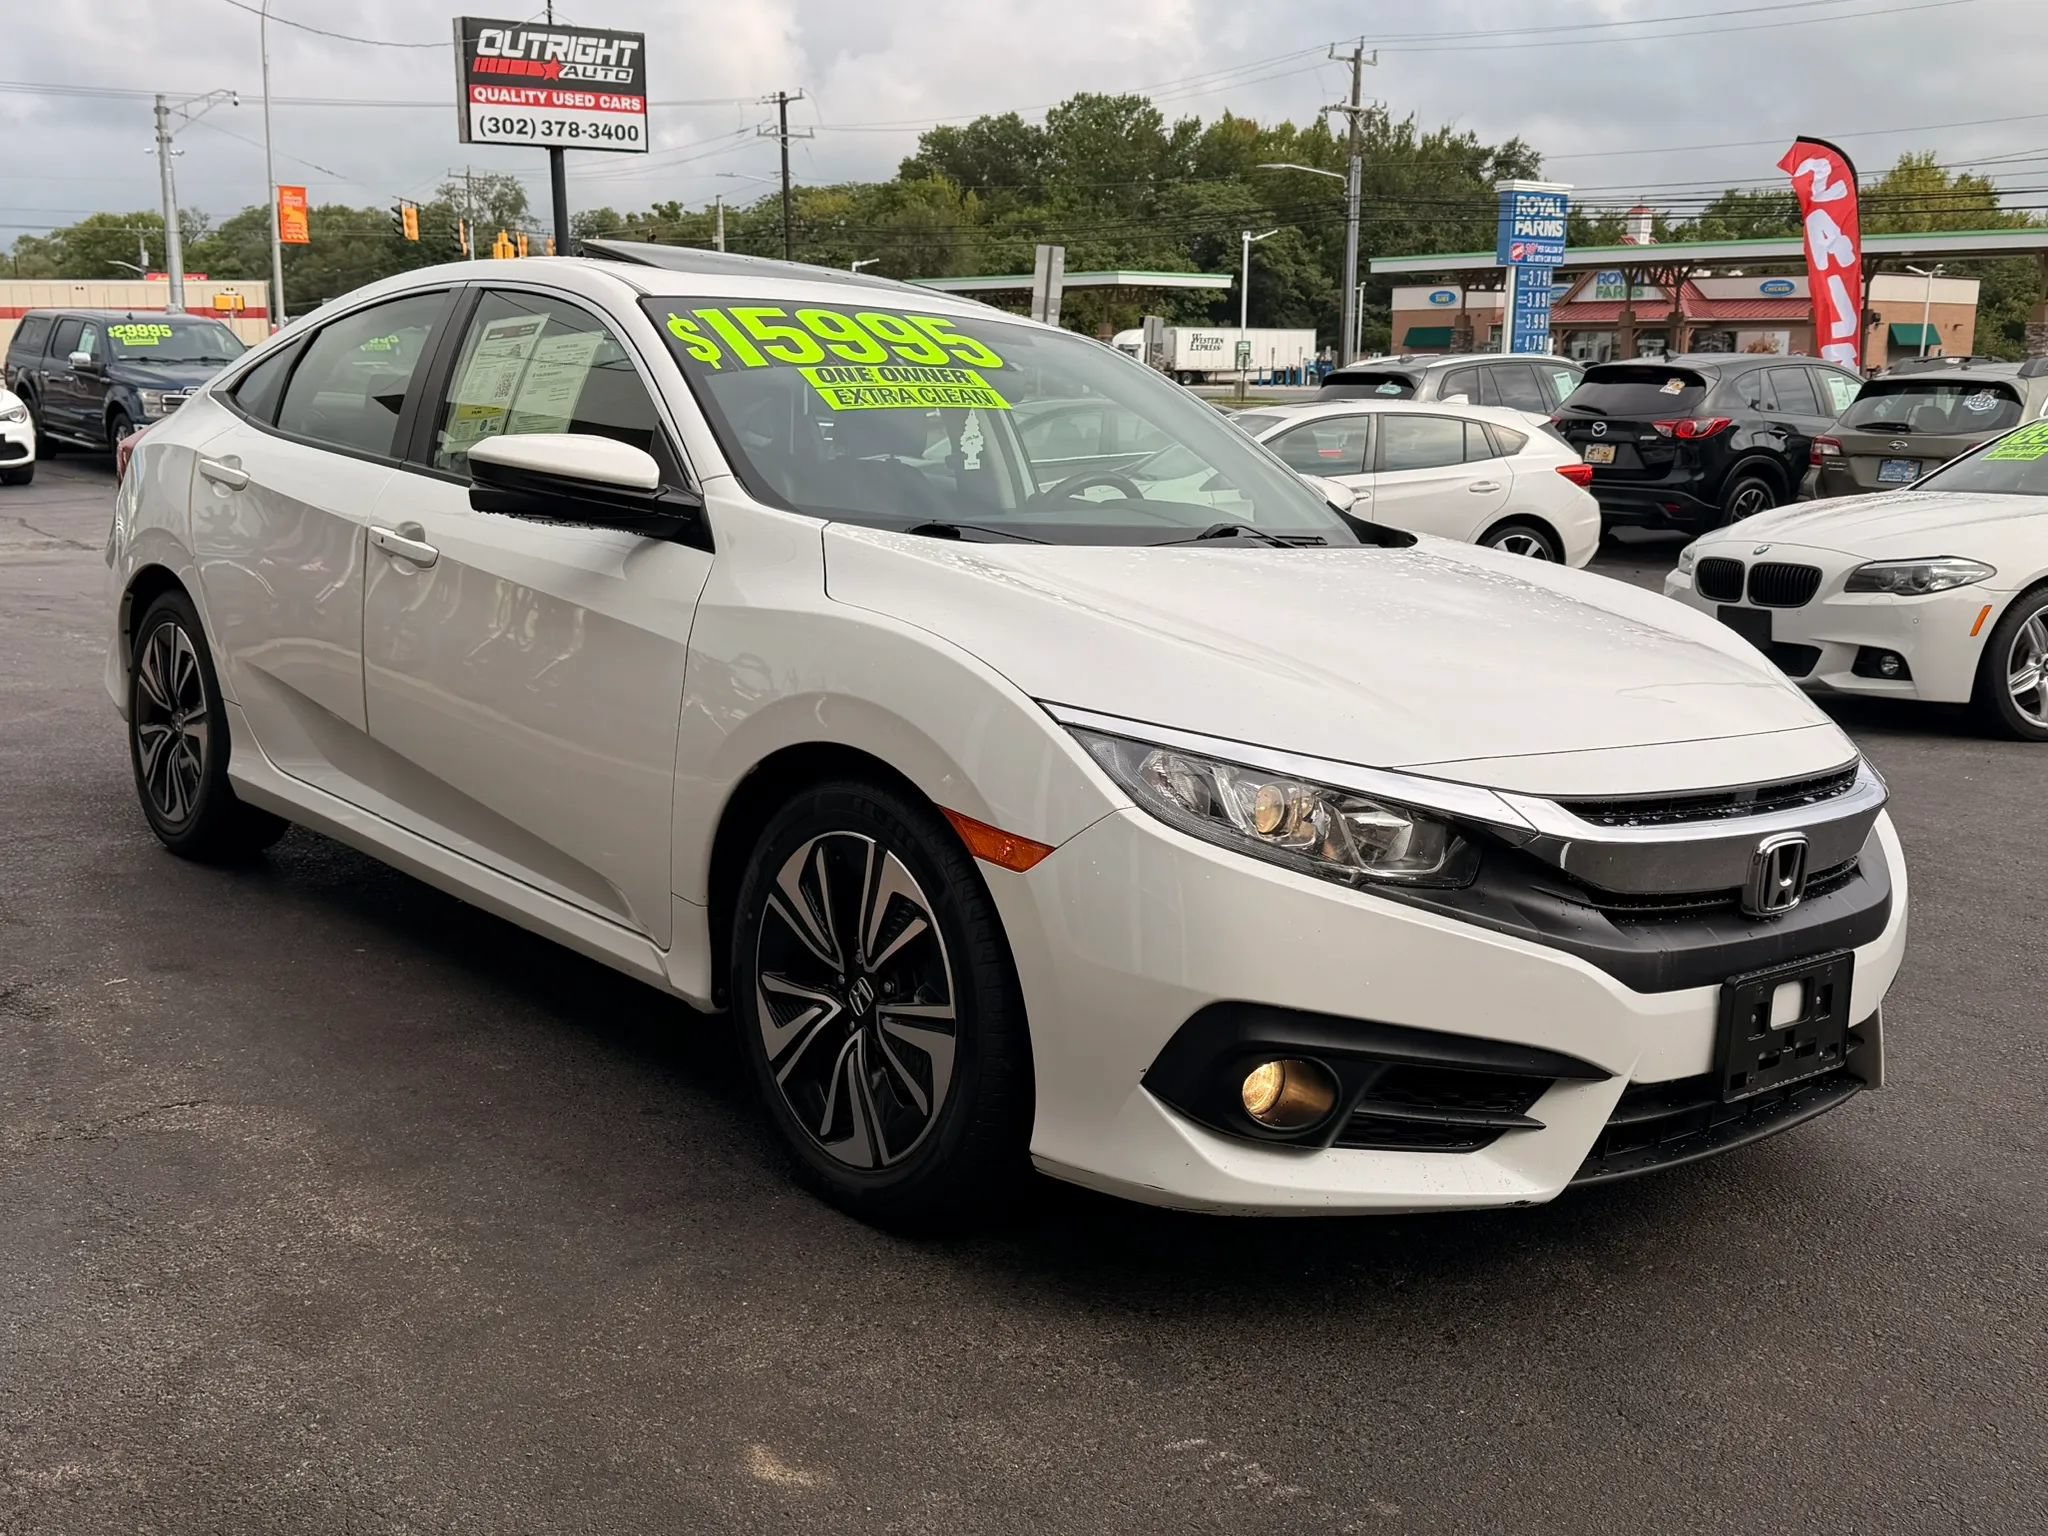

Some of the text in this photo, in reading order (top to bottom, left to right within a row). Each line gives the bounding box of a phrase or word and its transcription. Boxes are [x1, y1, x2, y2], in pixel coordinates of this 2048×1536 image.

[477, 28, 639, 67] OUTRIGHT
[563, 64, 632, 82] AUTO
[473, 87, 642, 111] QUALITY USED CARS
[479, 115, 639, 142] (302) 378-3400
[1515, 196, 1564, 217] ROYAL
[1514, 216, 1564, 237] FARMS
[1595, 285, 1645, 299] FARS
[107, 323, 173, 338] $29995
[666, 307, 1004, 370] $15995
[1191, 333, 1224, 344] WESTERN
[1190, 343, 1221, 351] EXPRESS
[815, 367, 973, 385] ONE OWNER
[833, 387, 996, 406] EXTRA CLEAN
